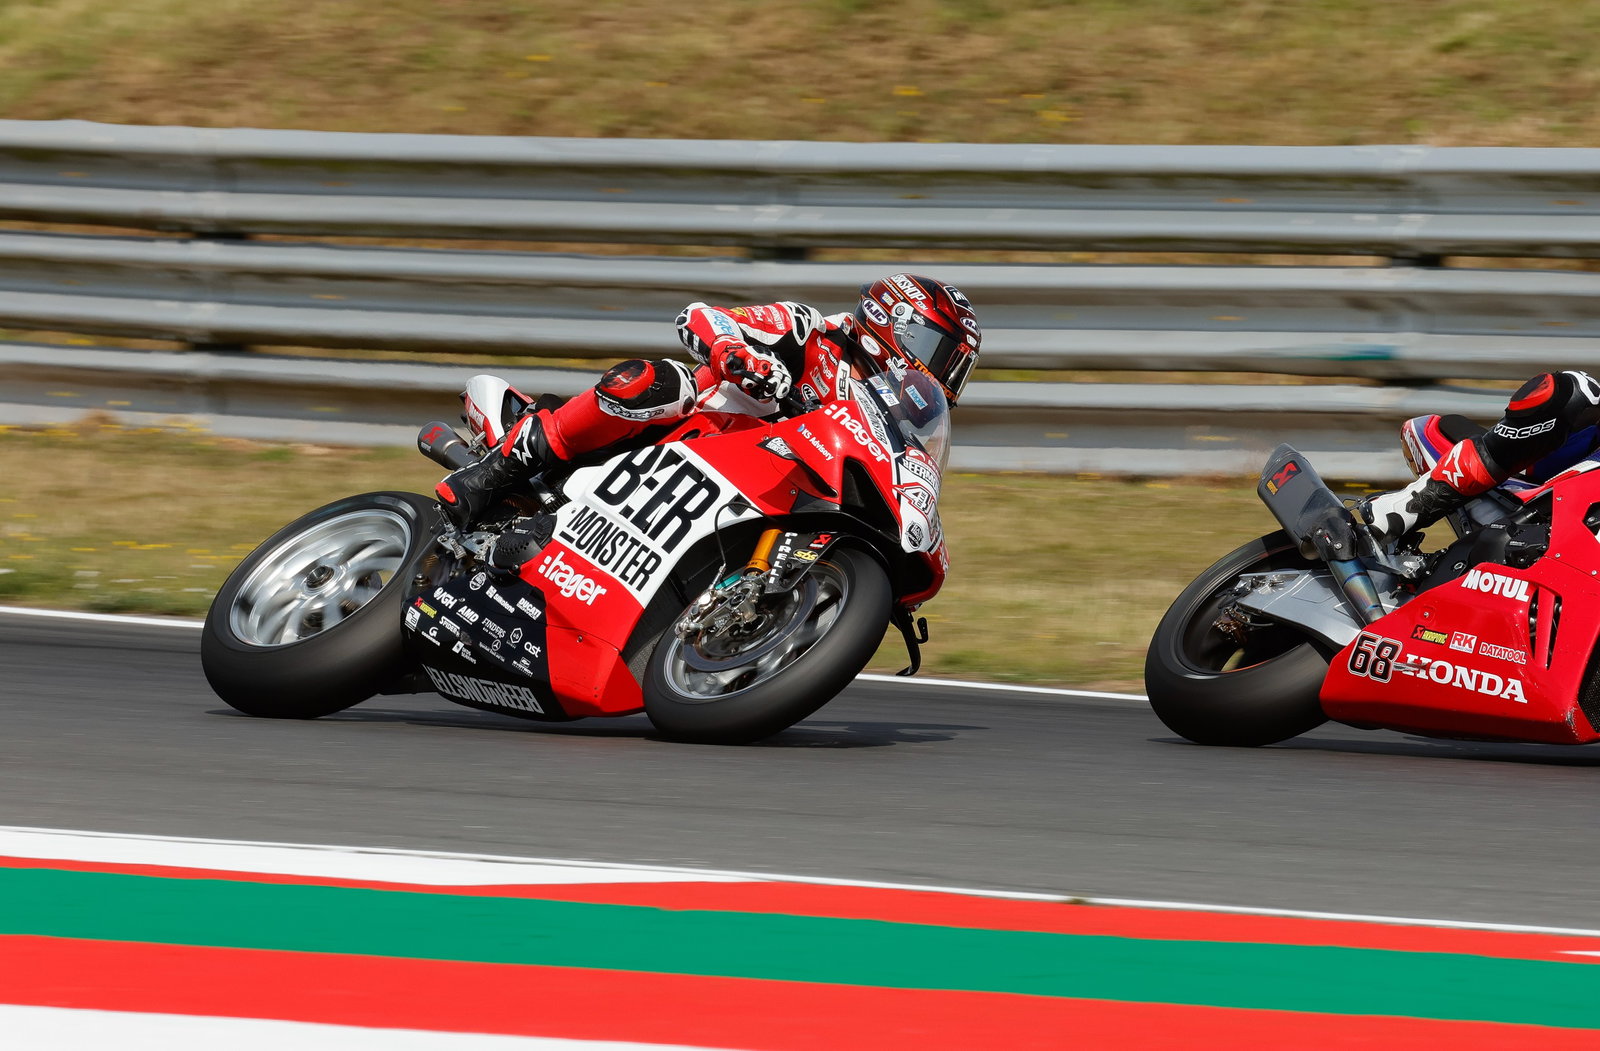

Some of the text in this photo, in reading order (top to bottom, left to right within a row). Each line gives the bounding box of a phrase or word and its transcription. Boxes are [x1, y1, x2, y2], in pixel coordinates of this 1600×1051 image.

[864, 301, 886, 322] HJC
[1493, 417, 1557, 440] VIRCOS
[802, 428, 834, 461] KS Advisory
[594, 444, 721, 555] BEER
[560, 505, 662, 593] MONSTER
[795, 550, 818, 561] sbs
[1461, 569, 1530, 602] MOTUL
[458, 605, 480, 623] AMD
[518, 597, 542, 618] DUCATI
[524, 641, 542, 658] ast
[1452, 633, 1476, 650] RK
[1347, 631, 1402, 684] 68
[1479, 642, 1527, 665] DATATOOL
[422, 663, 545, 715] BEERMONSTER
[1401, 653, 1528, 704] HONDA
